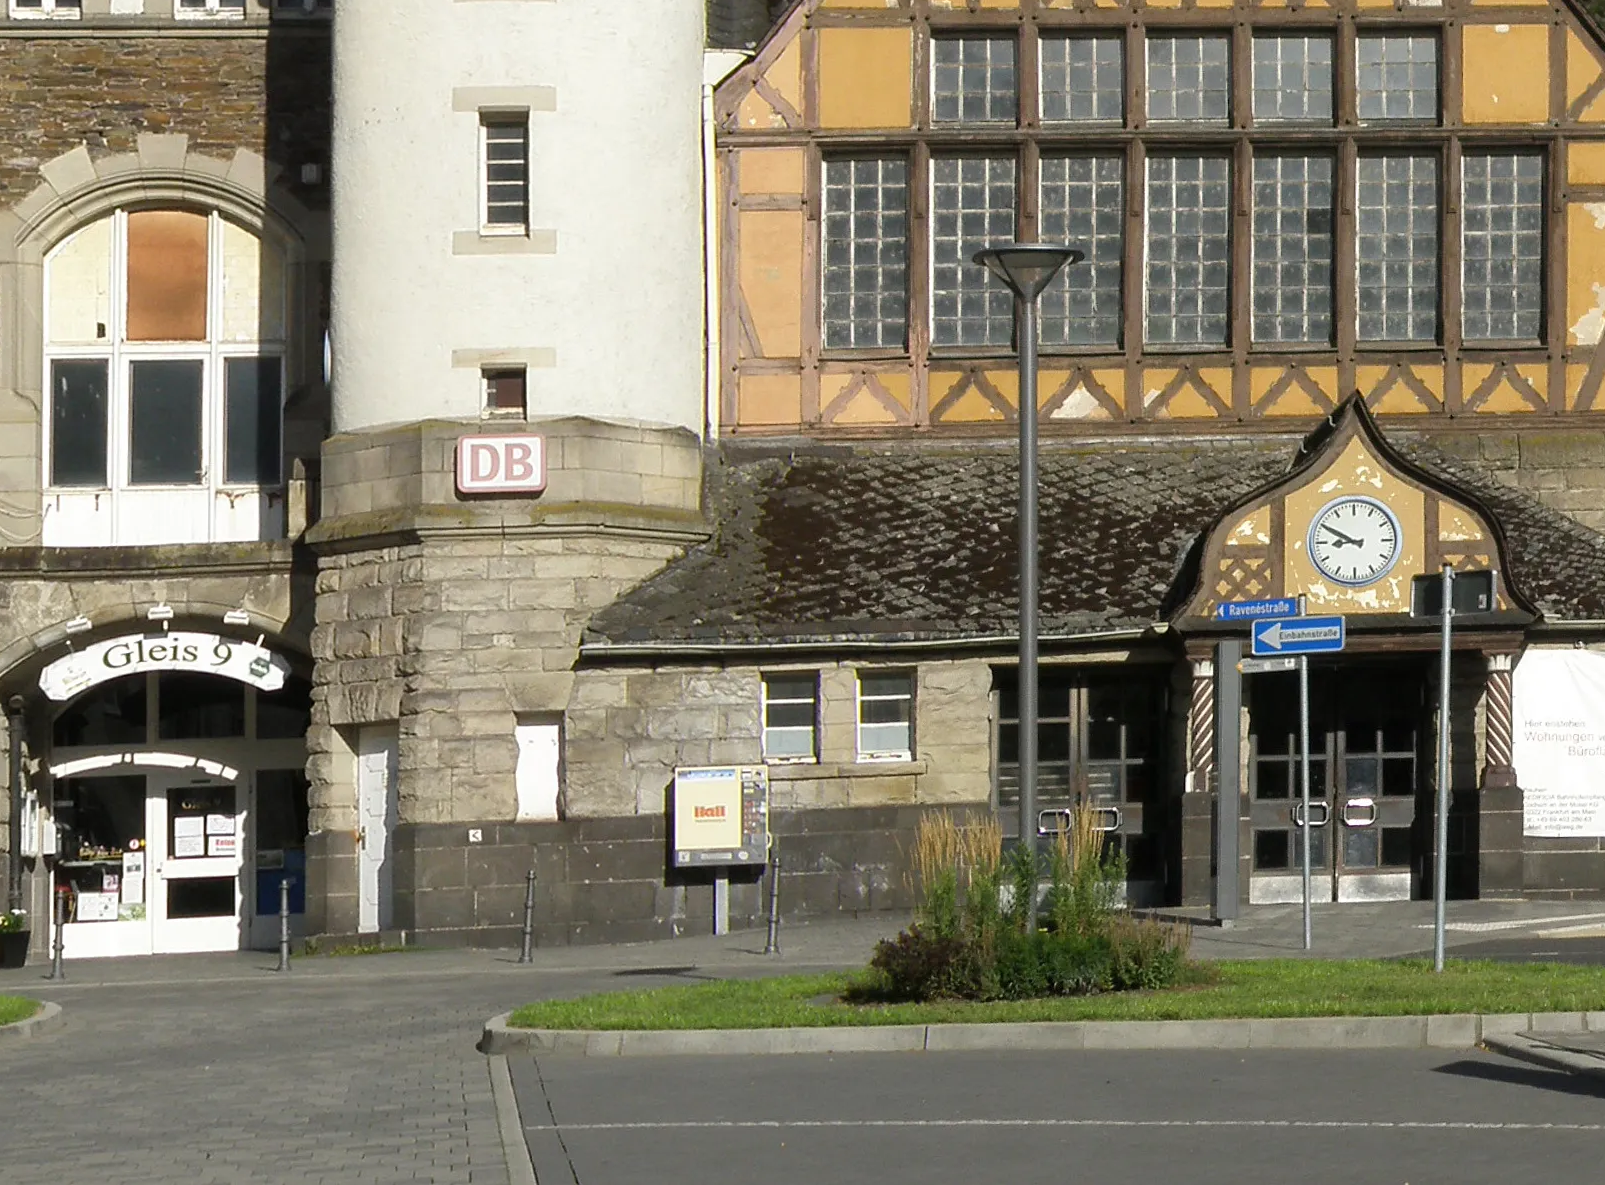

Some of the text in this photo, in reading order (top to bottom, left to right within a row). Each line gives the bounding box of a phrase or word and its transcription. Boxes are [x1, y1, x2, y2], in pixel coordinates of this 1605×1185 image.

[470, 443, 534, 482] DB
[1229, 600, 1290, 616] Ravenéstraße
[1279, 628, 1338, 640] Einbahnstraße
[102, 638, 232, 669] Gleis 9
[1524, 720, 1542, 728] Hier
[1524, 732, 1594, 744] Wohnungen
